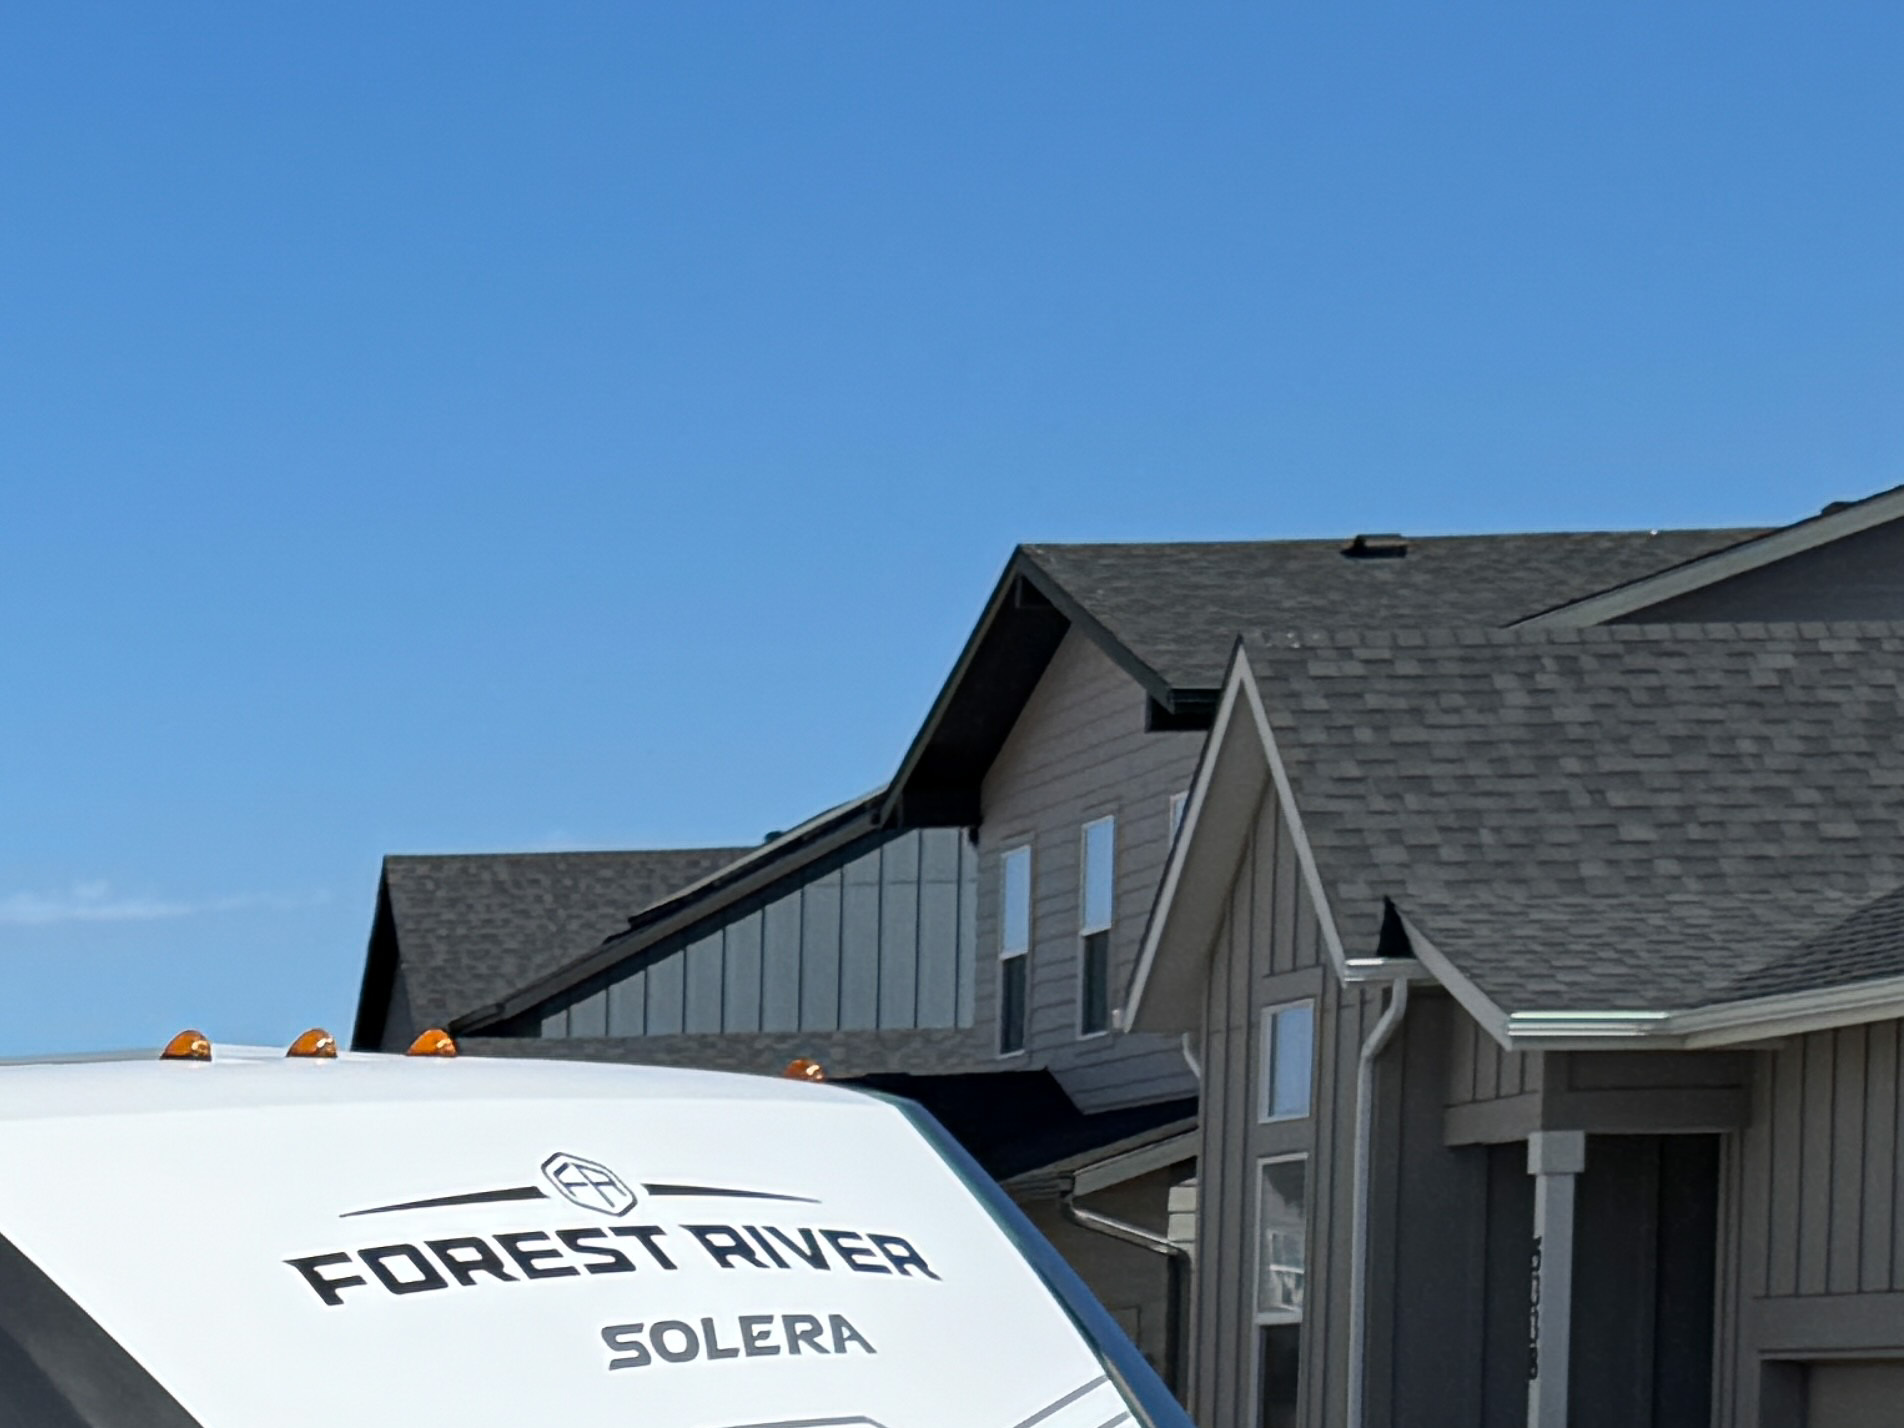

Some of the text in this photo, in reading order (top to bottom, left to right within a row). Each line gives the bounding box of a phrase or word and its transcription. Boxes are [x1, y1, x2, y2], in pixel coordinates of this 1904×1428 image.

[283, 1223, 942, 1306] FOREST RIVER
[601, 1313, 877, 1370] SOLERA
